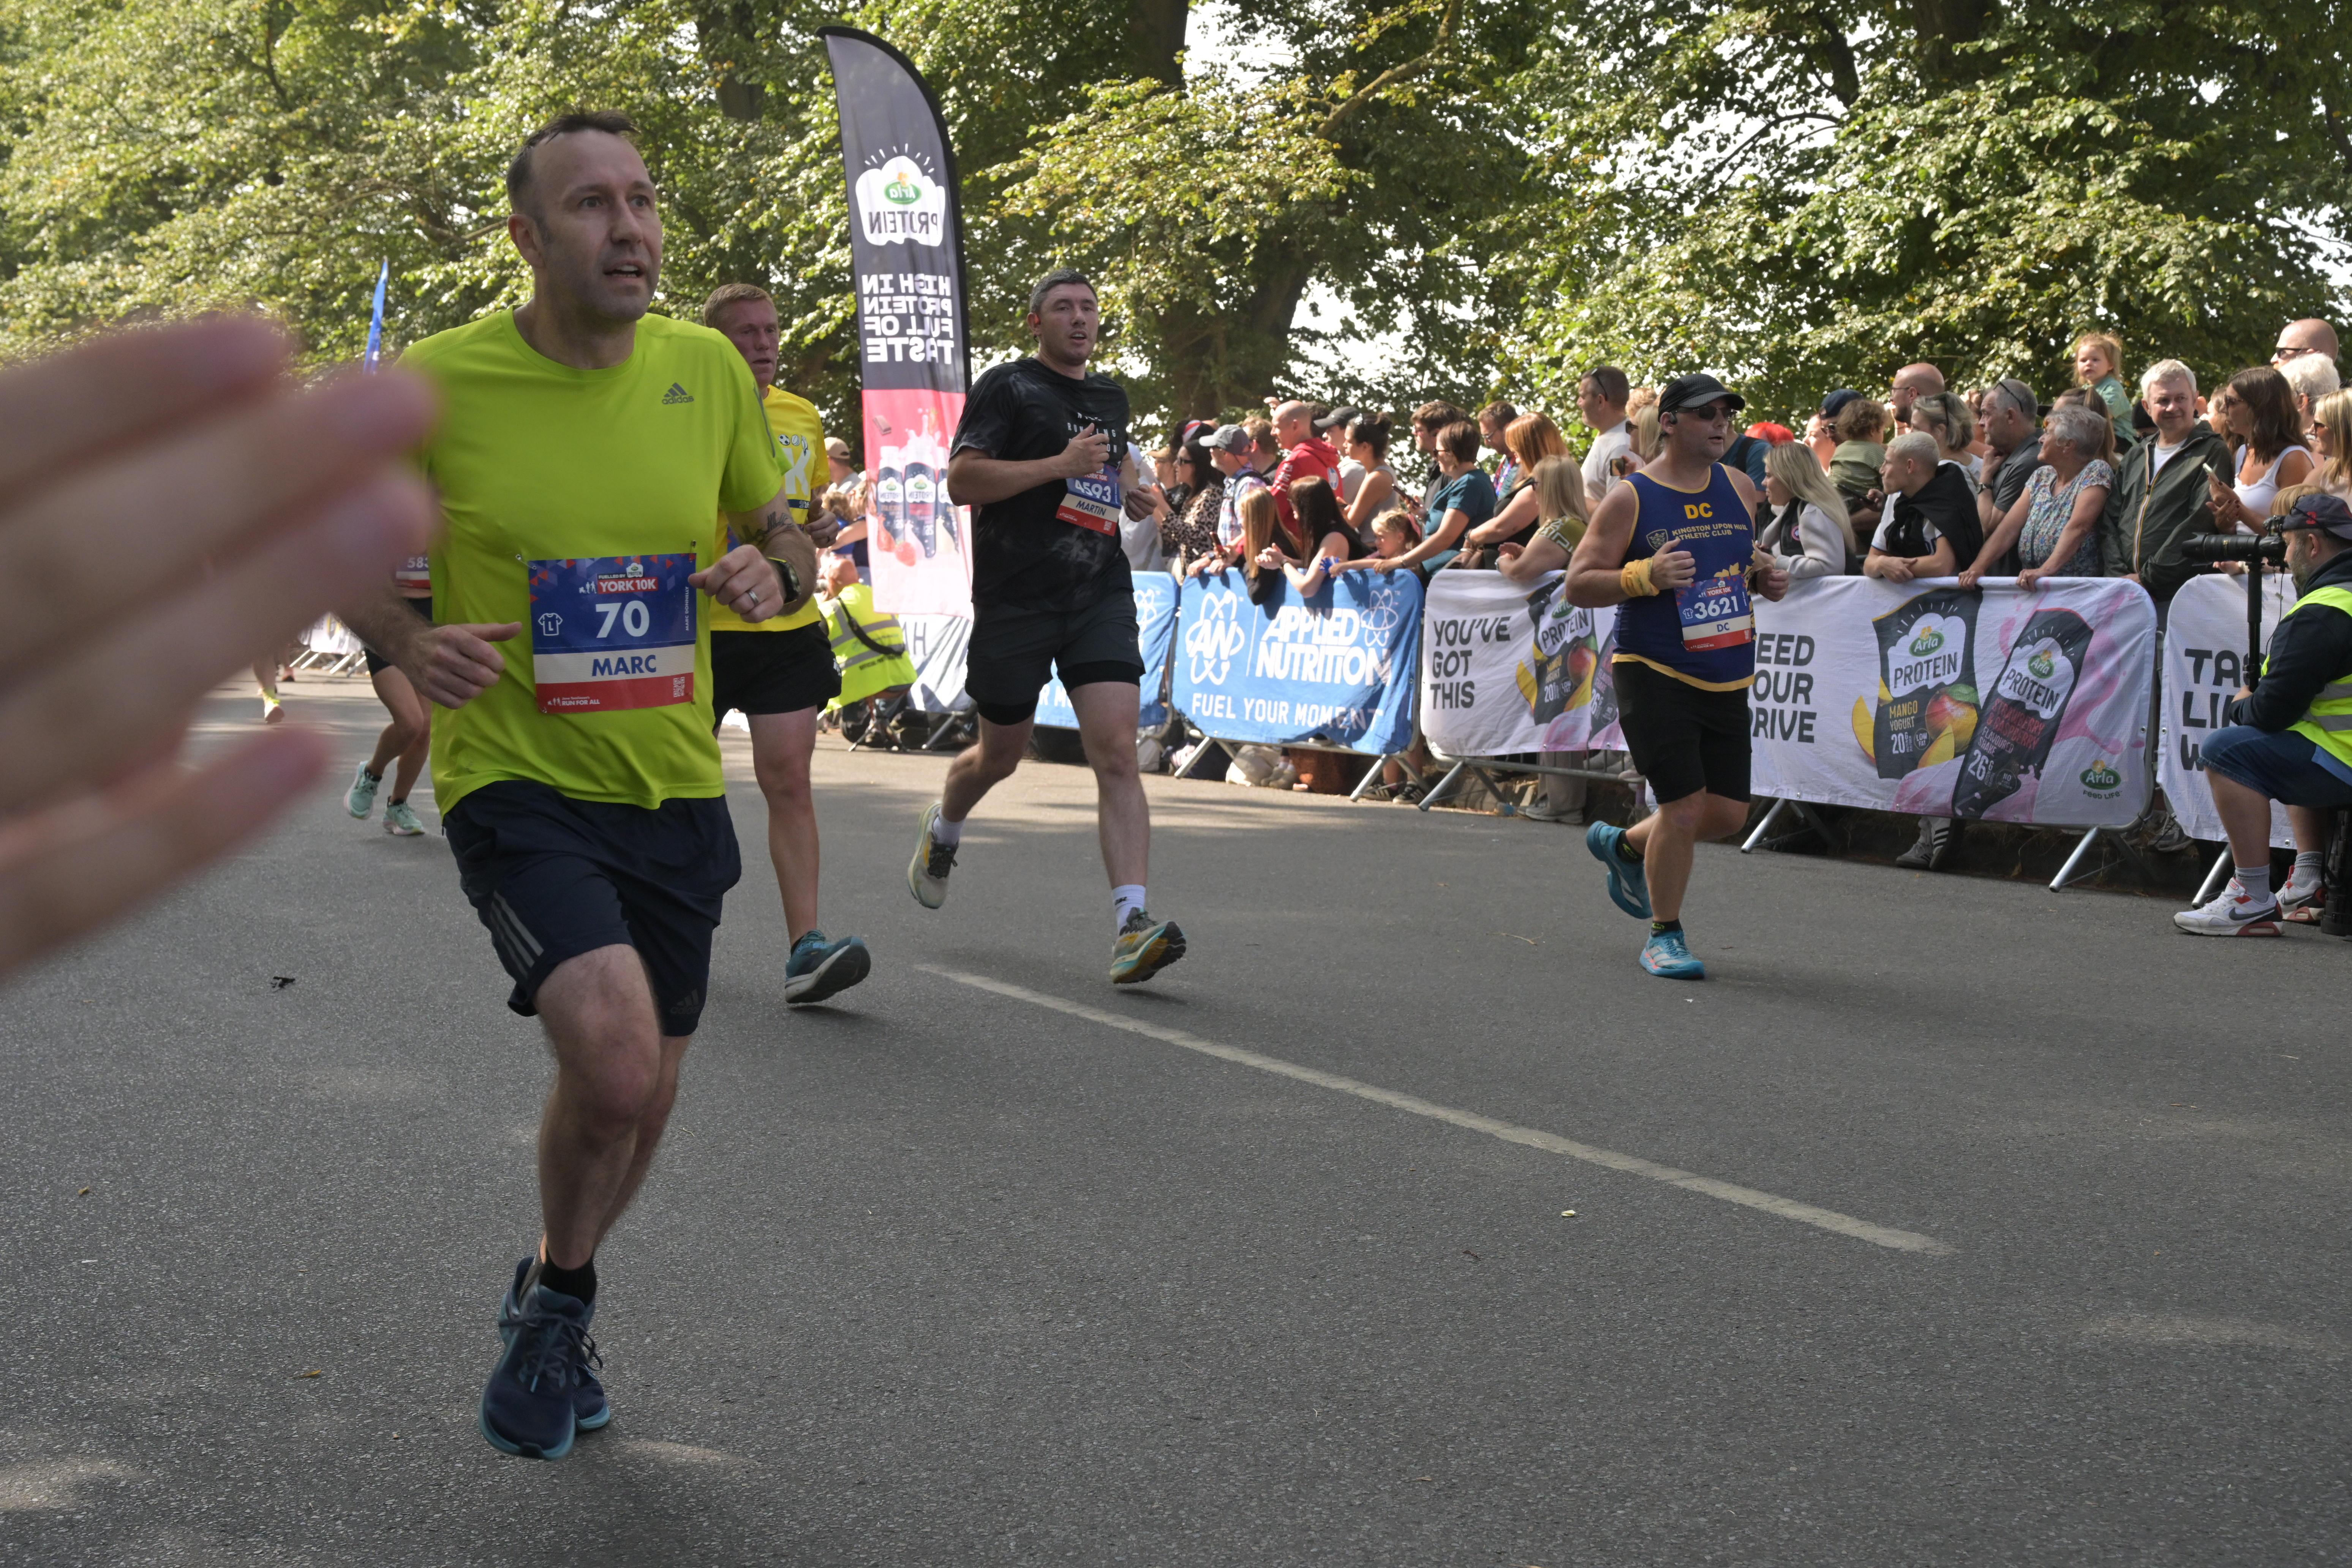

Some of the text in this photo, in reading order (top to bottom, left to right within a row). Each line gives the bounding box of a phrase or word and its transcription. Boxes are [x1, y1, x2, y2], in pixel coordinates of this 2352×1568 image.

[1067, 422, 1116, 437] RUNING
[1075, 479, 1111, 502] 4593
[1076, 501, 1106, 516] MARTIN
[1684, 503, 1713, 519] DC
[1672, 525, 1710, 536] KINGSTON
[599, 579, 656, 592] YORK 10K
[1694, 596, 1739, 619] 3621
[548, 621, 553, 631] L
[596, 601, 649, 638] 70
[1261, 606, 1359, 645] APPLIED
[1434, 616, 1511, 646] YOU'VE
[1542, 609, 1589, 649] PROTEIN
[1717, 623, 1729, 632] DC
[1756, 633, 1815, 666] EED
[1914, 636, 1939, 653] Arla
[592, 654, 656, 677] MARC
[1255, 642, 1392, 686] NUTRITION
[1433, 650, 1472, 678] GOT
[1894, 652, 1958, 688] PROTEIN
[2031, 658, 2050, 675] Arla
[1430, 681, 1475, 709] THIS
[1750, 669, 1813, 705] OUR
[2003, 668, 2060, 712] PROTEIN
[1192, 693, 1383, 732] FUEL YOUR MOMENT
[1889, 700, 1918, 719] MANGO
[1890, 716, 1915, 731] YOGURT
[1891, 733, 1905, 754] 20
[1916, 732, 1927, 741] LOW
[1978, 737, 1997, 757] SHAKE
[1982, 726, 2014, 754] FLAVOURED
[1968, 749, 1989, 781] 26
[2003, 773, 2012, 781] NO
[2086, 771, 2113, 784] Arla
